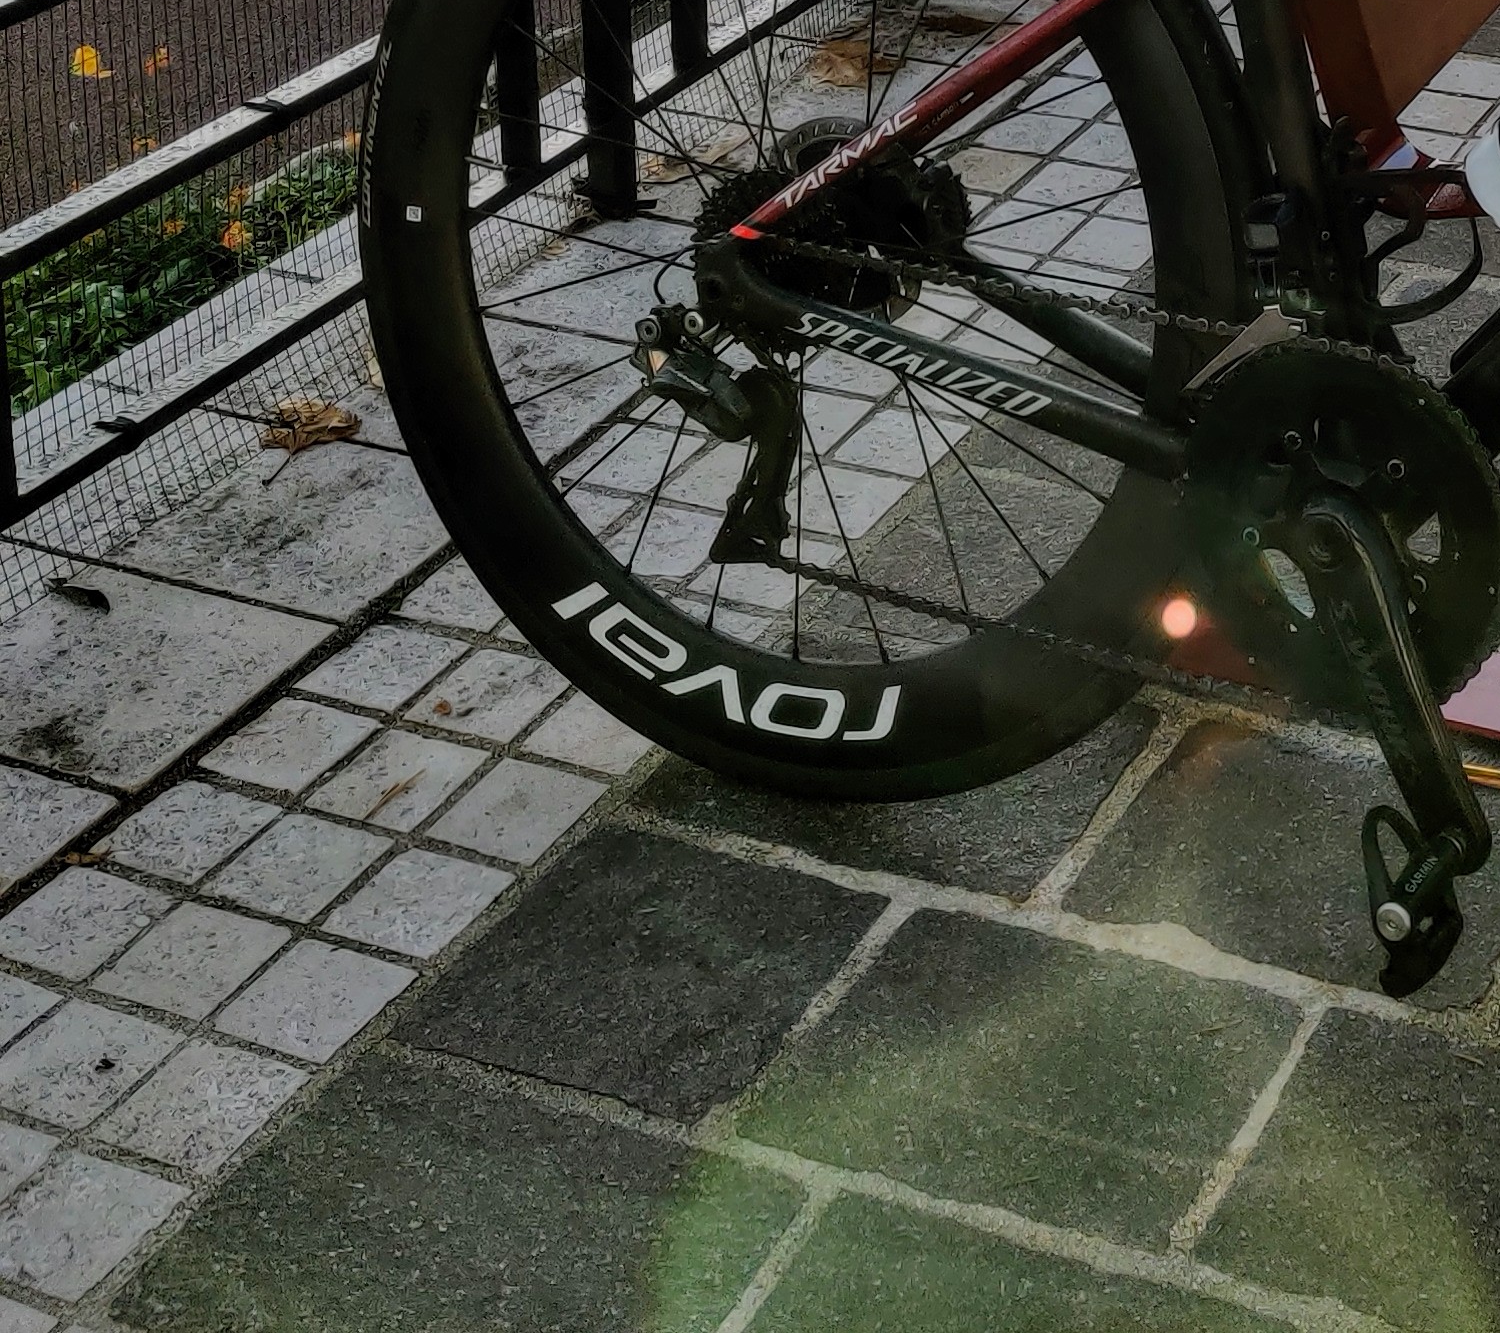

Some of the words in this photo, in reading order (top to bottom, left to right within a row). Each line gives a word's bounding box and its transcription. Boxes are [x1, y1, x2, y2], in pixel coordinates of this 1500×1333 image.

[774, 101, 919, 209] TARMAC
[798, 311, 1053, 417] SPECIALIZED
[550, 581, 902, 742] roval
[1404, 856, 1440, 893] GARMIN
